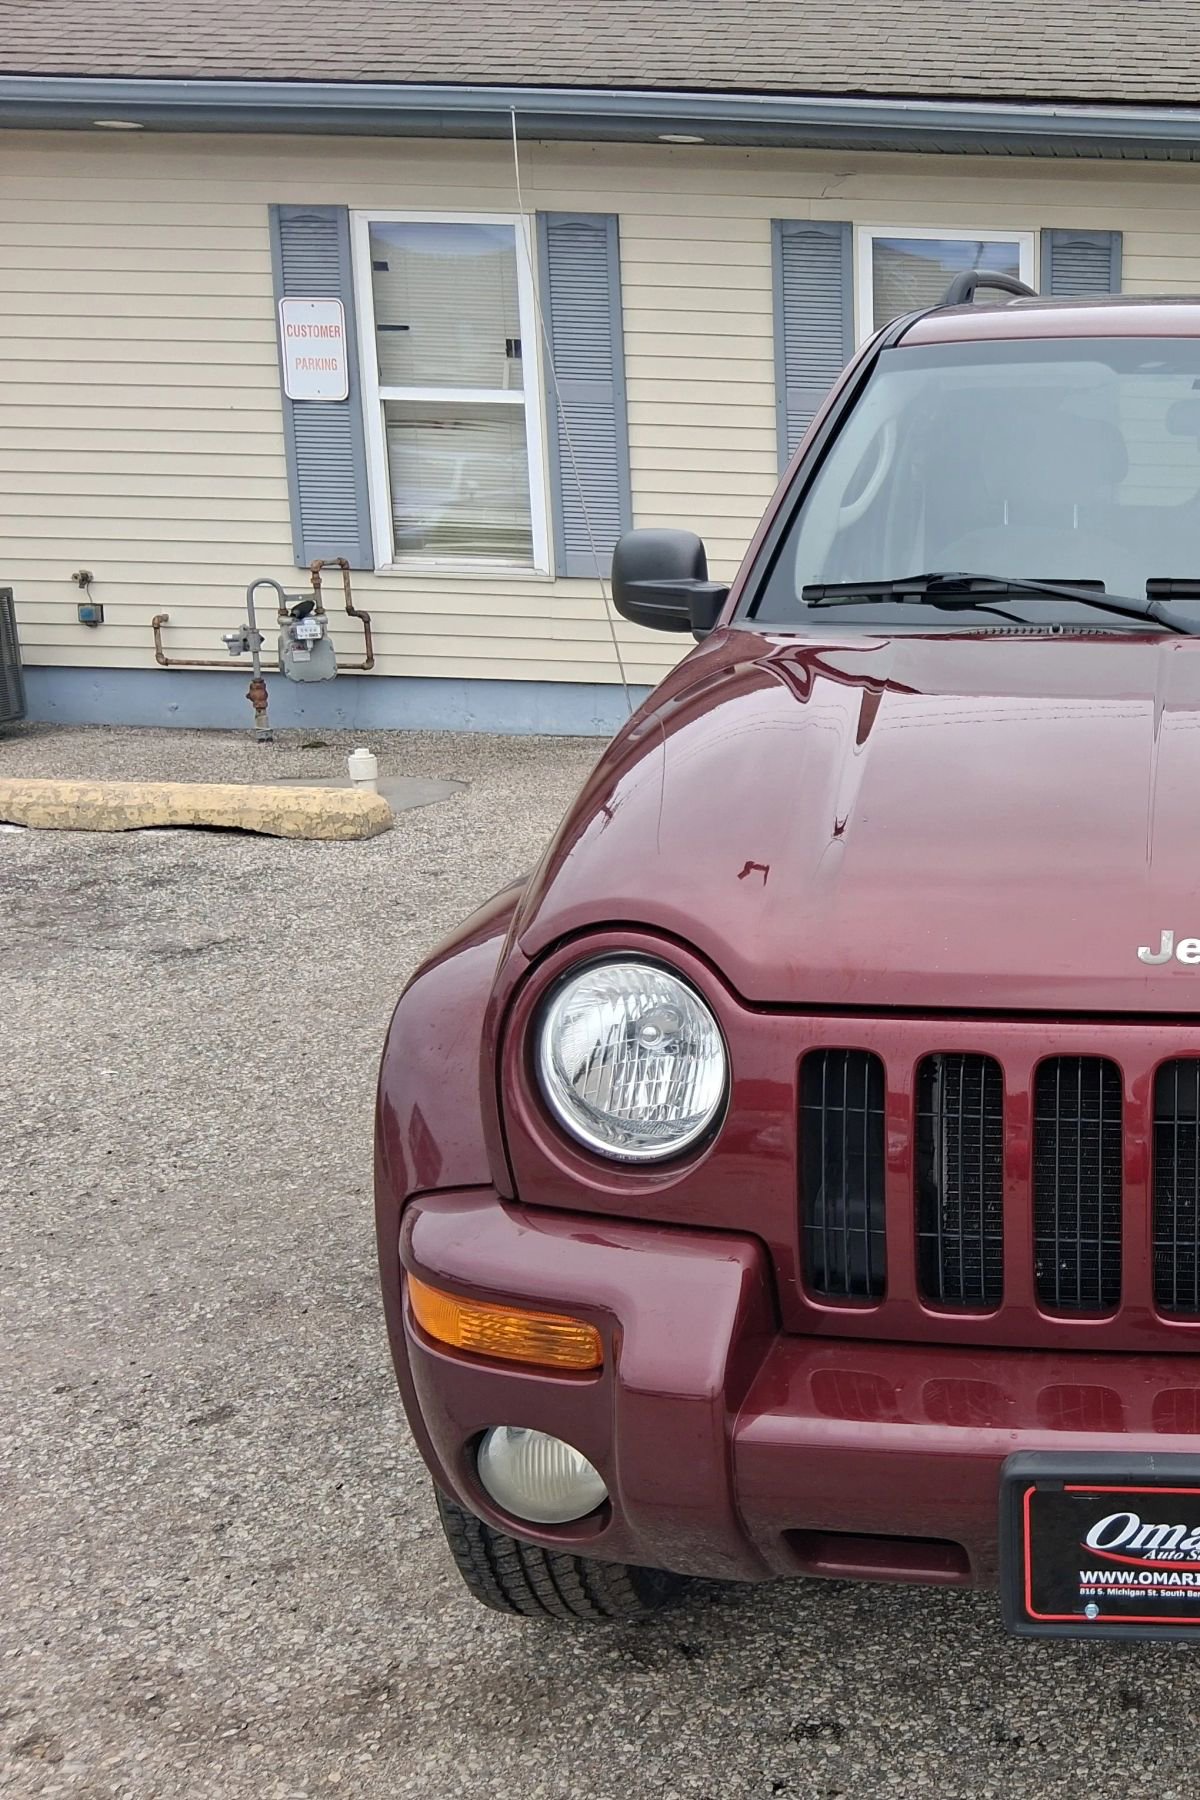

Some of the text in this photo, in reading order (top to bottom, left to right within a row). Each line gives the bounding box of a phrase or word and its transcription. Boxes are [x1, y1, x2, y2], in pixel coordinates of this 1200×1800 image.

[286, 324, 341, 339] CUSTOMER
[295, 357, 338, 371] PARKING
[1142, 1549, 1185, 1561] Auto
[1097, 1588, 1105, 1596] S.
[1107, 1588, 1146, 1598] Michigan
[1147, 1589, 1159, 1597] St.
[1160, 1589, 1185, 1598] South
